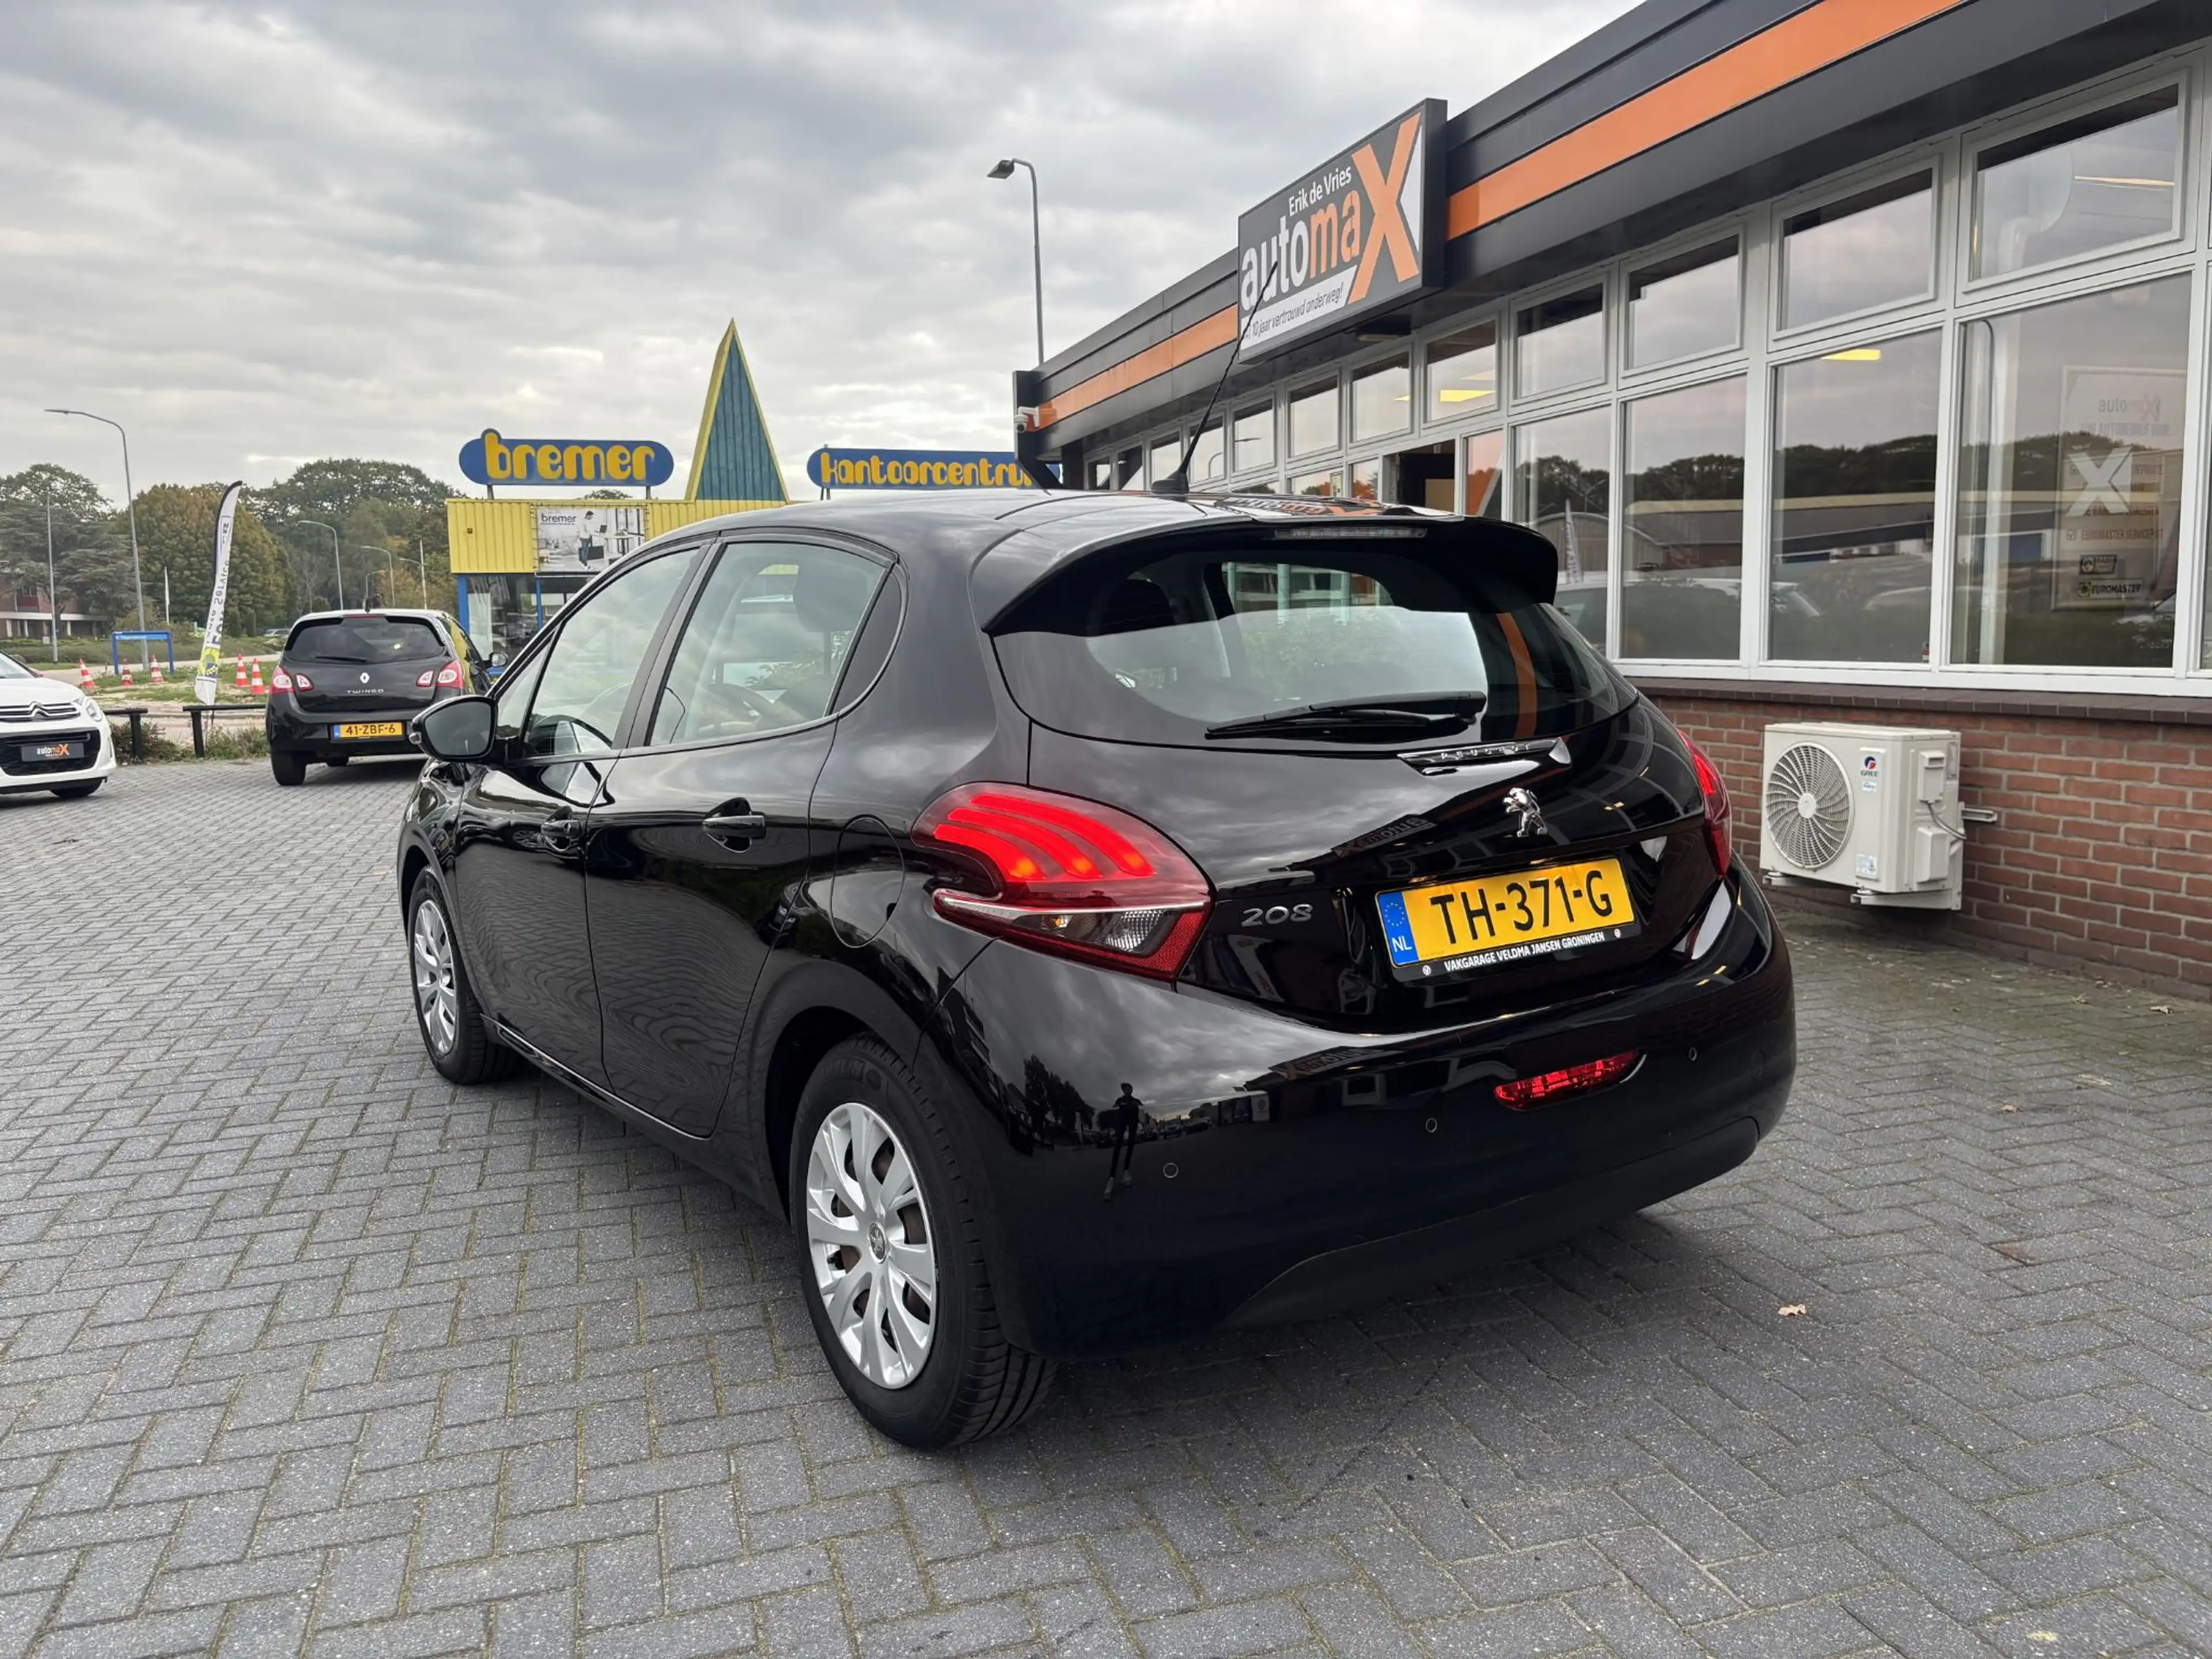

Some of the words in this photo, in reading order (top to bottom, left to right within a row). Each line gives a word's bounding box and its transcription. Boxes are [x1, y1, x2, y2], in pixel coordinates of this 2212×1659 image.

[1289, 188, 1309, 217] Erik
[1309, 181, 1323, 204] de
[1324, 166, 1352, 195] Vries
[1272, 299, 1305, 329] vertrouwd
[1305, 282, 1343, 313] onderweg!
[484, 433, 655, 480] bremer
[541, 513, 576, 522] bremer
[346, 724, 396, 735] 41-ZBF-6
[1241, 904, 1313, 926] 208
[1430, 870, 1612, 944] TH-371-G
[1392, 935, 1412, 953] NL
[1444, 952, 1497, 972] VAKGARAGE
[1496, 945, 1531, 961] VELDMA
[1531, 940, 1562, 955] JANSEN
[1562, 931, 1605, 948] GRONINGEN
